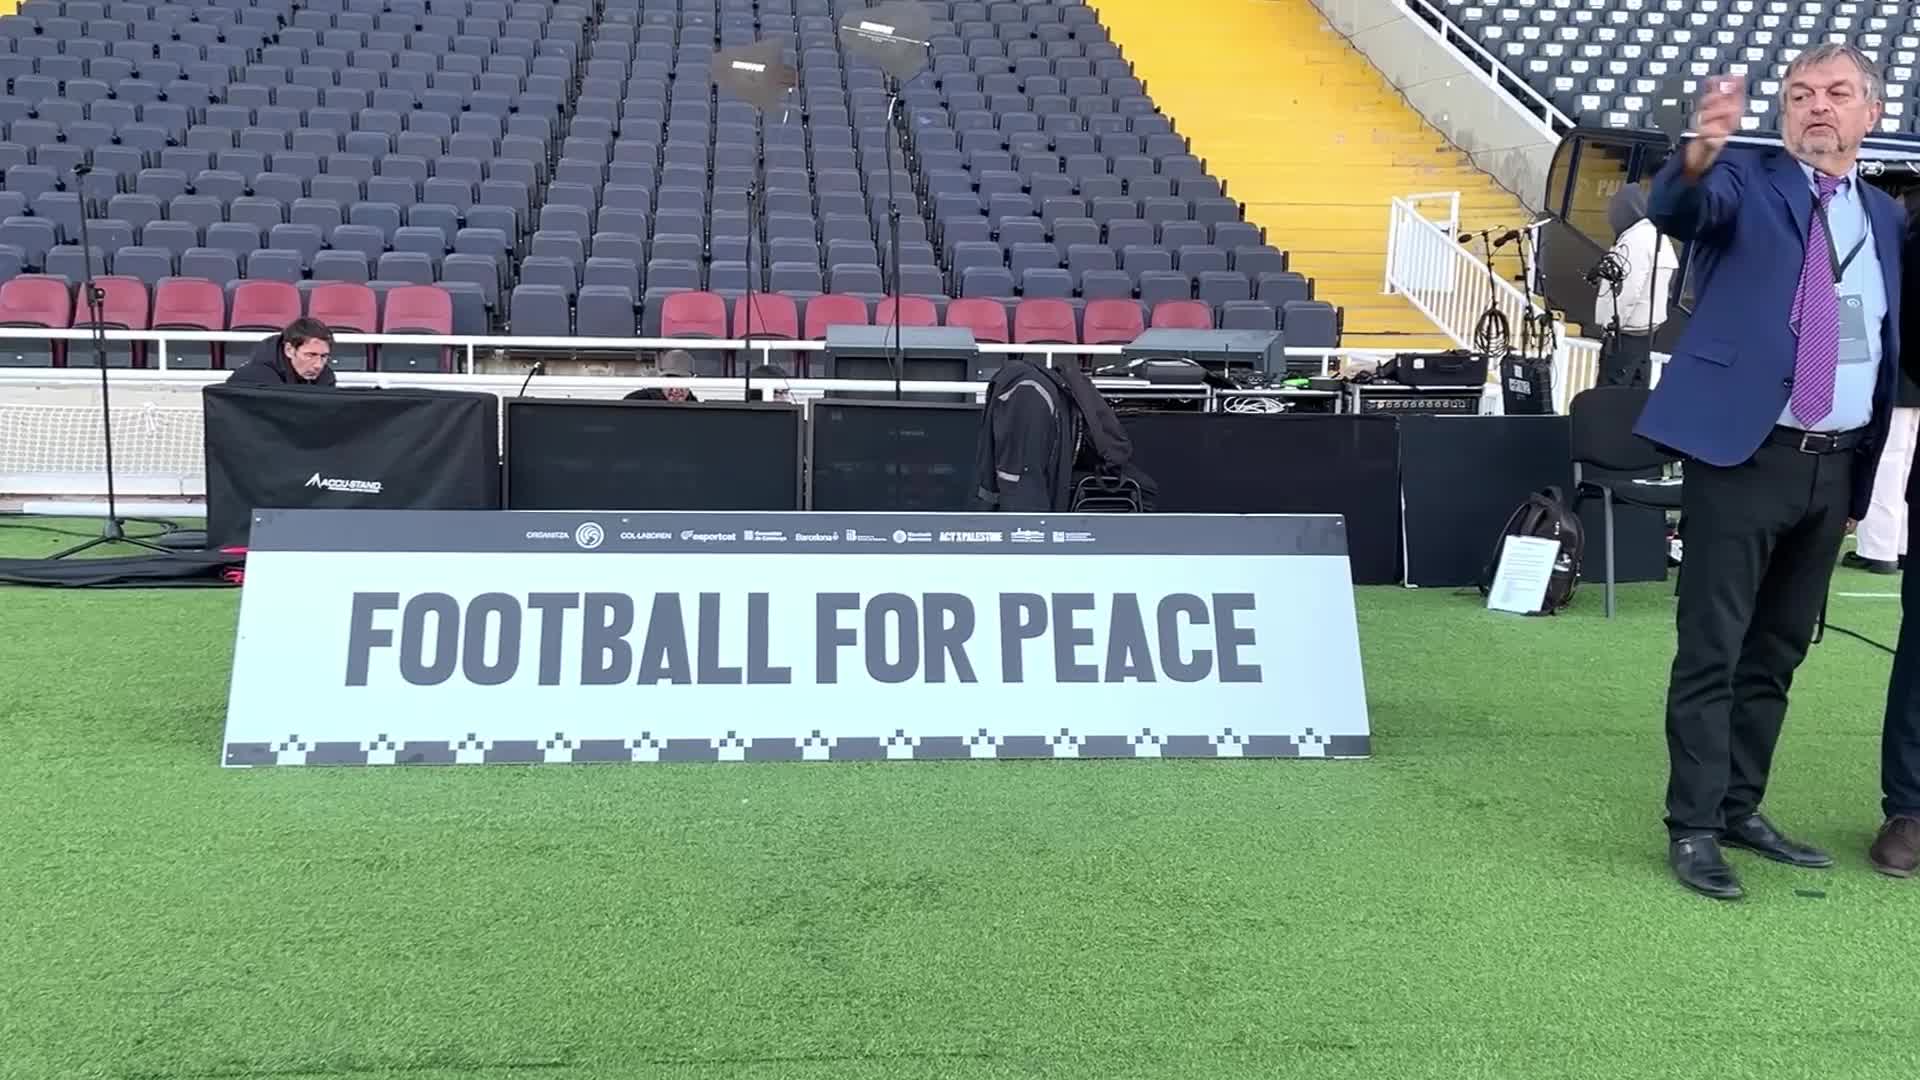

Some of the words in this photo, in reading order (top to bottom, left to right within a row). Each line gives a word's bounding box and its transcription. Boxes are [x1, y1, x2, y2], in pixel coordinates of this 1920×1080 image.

[344, 591, 792, 687] FOOTBALL
[815, 591, 979, 685] FOR
[998, 591, 1263, 683] PEACE
